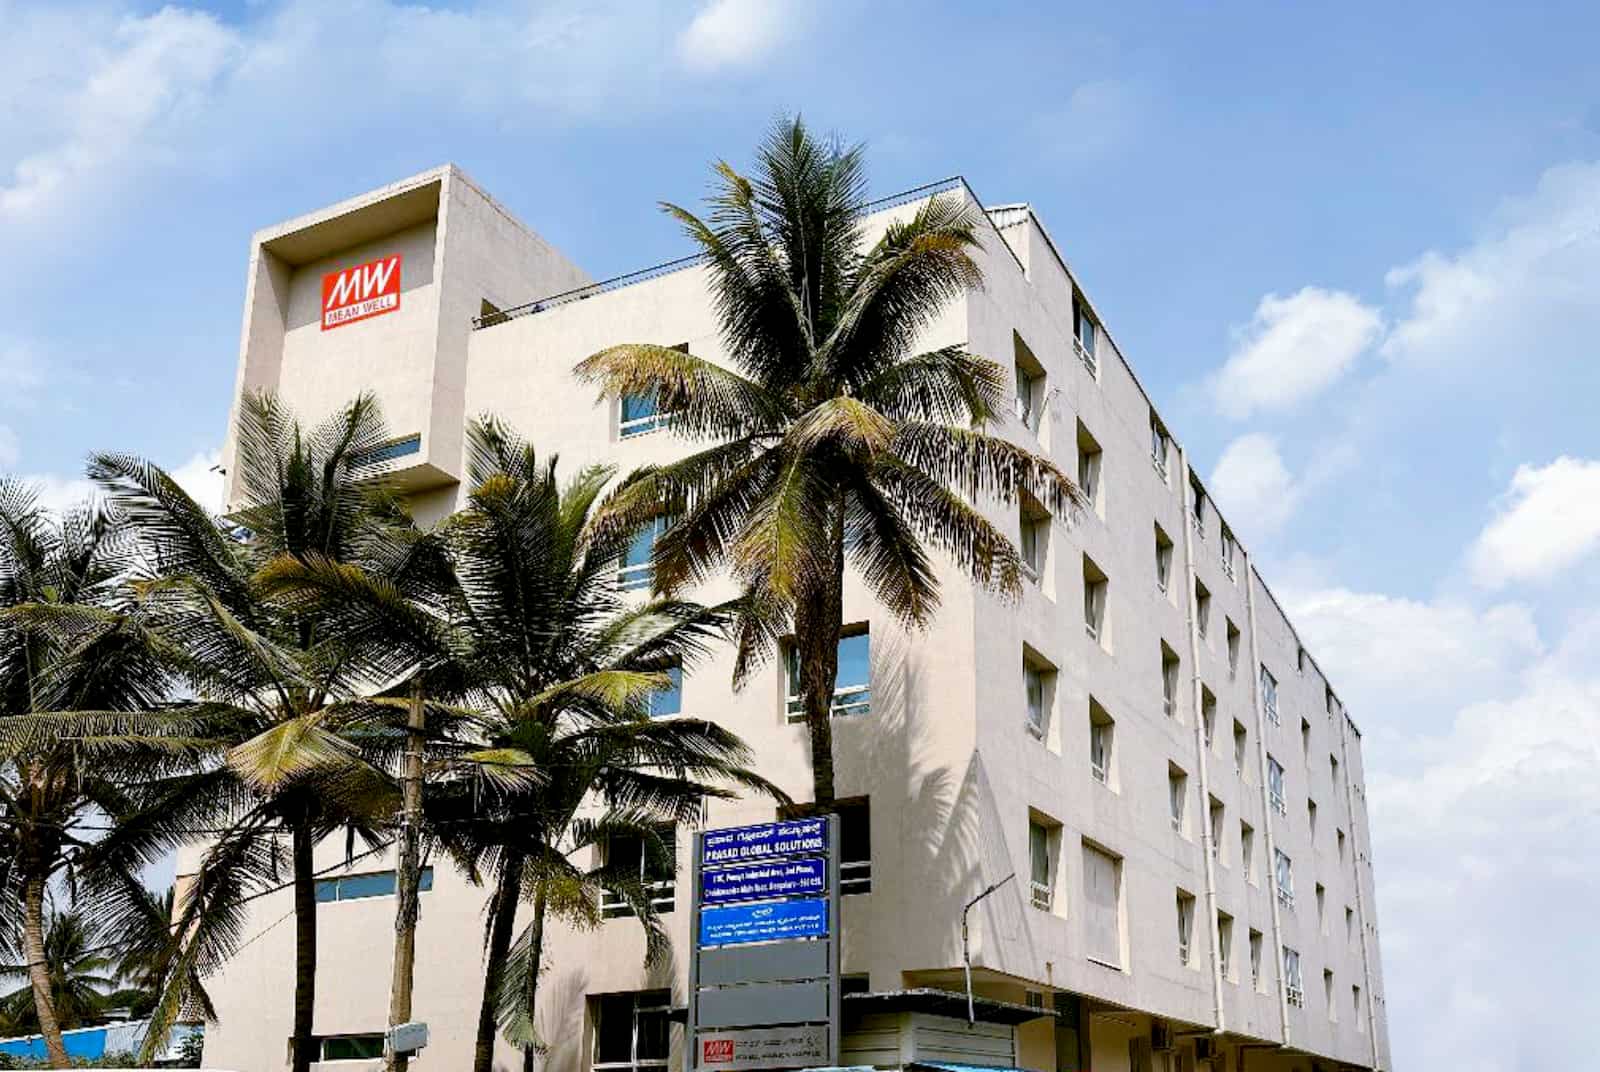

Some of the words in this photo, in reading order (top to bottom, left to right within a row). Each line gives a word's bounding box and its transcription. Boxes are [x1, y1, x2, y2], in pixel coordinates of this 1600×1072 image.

[326, 257, 398, 310] MW
[328, 306, 360, 323] MEAN
[363, 295, 393, 313] WELL
[706, 849, 738, 861] PRASAD
[741, 844, 773, 857] GLOBAL
[775, 837, 822, 852] SOLUTIONS
